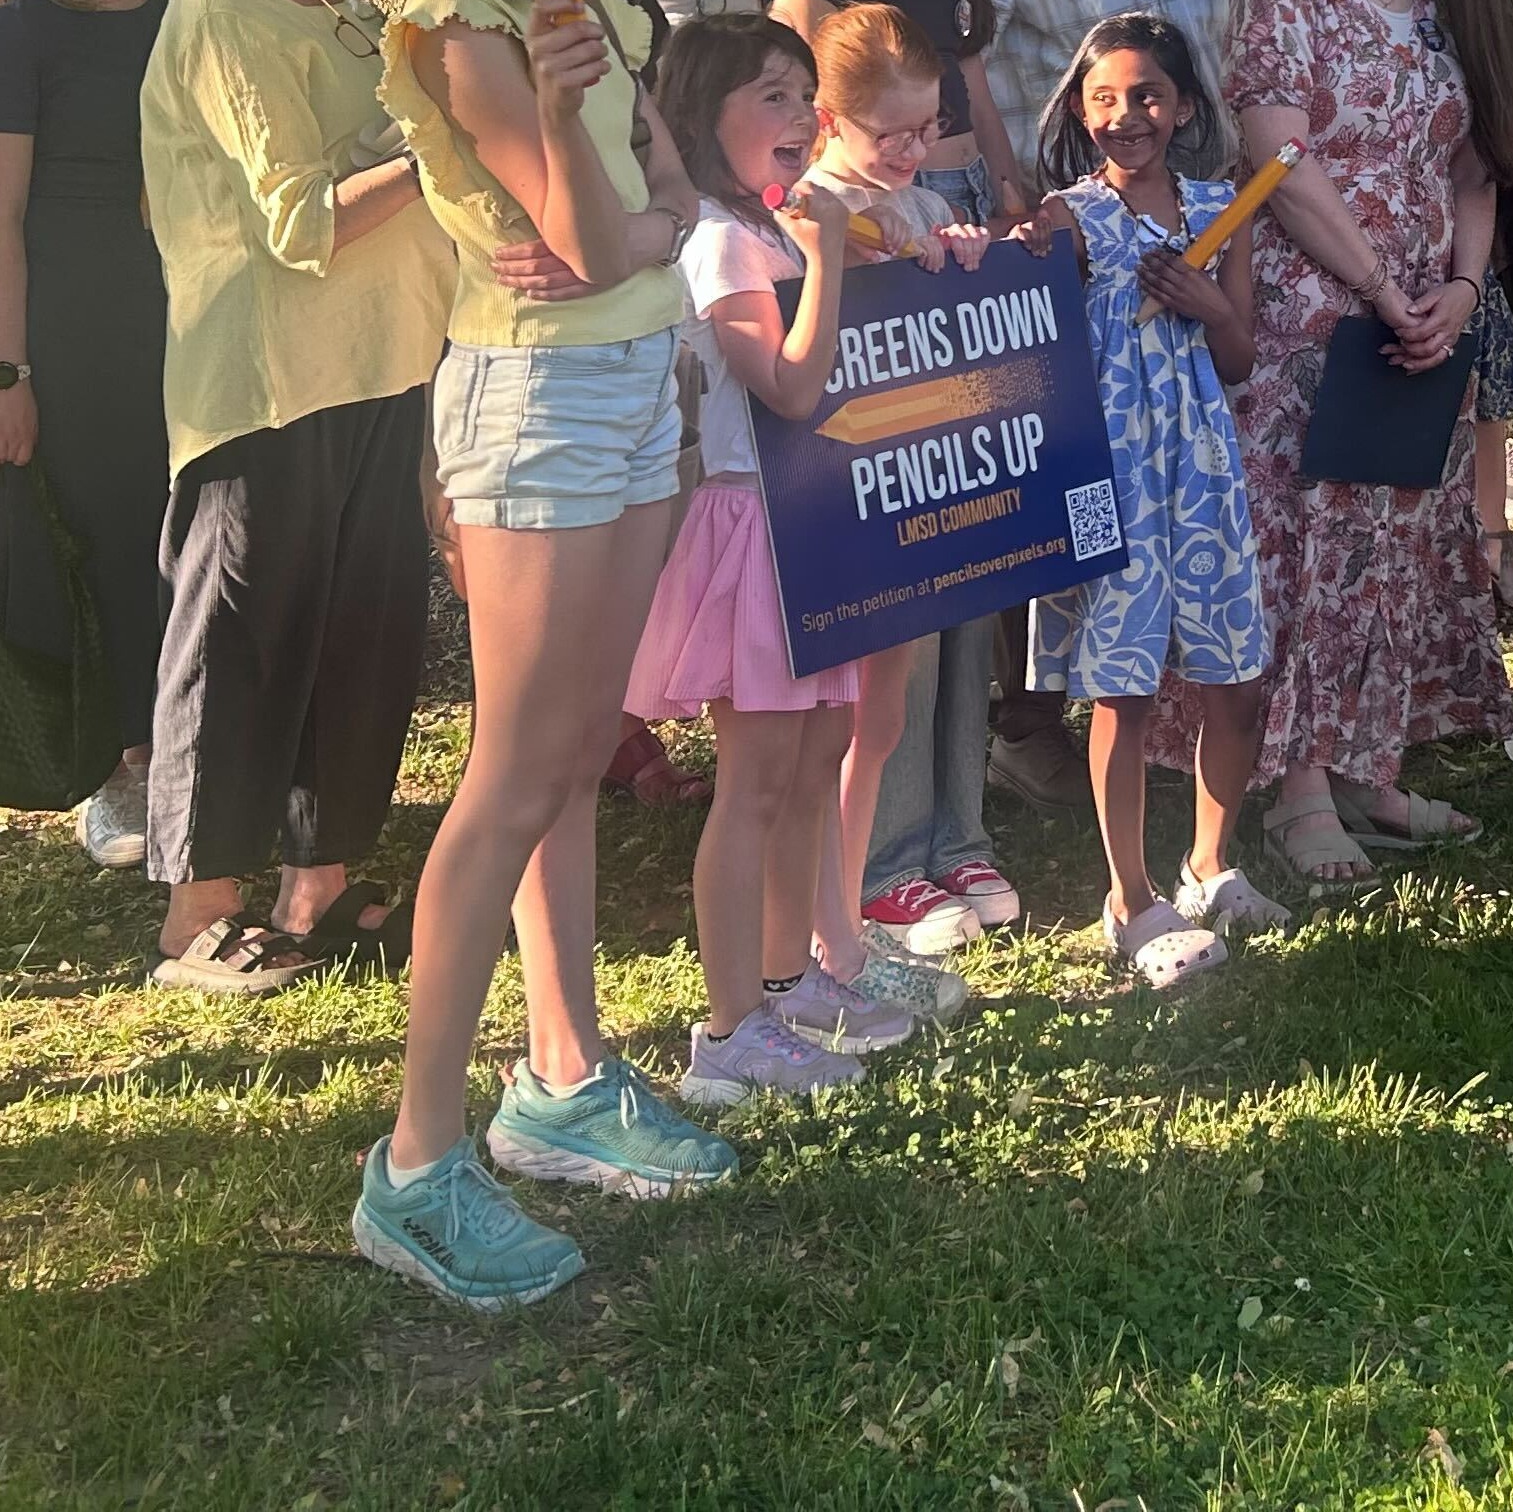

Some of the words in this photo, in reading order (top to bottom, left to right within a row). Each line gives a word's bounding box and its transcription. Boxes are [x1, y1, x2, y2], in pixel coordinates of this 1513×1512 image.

[957, 285, 1059, 361] DOWN
[850, 424, 999, 520] PENCILS
[1000, 413, 1045, 478] UP
[896, 510, 939, 547] LMSD
[940, 488, 1022, 533] COMMUNITY
[801, 609, 835, 634] Sign
[837, 601, 860, 621] the
[862, 582, 915, 617] petition
[917, 578, 931, 595] at
[933, 536, 1067, 591] pencilsoverpixels.org
